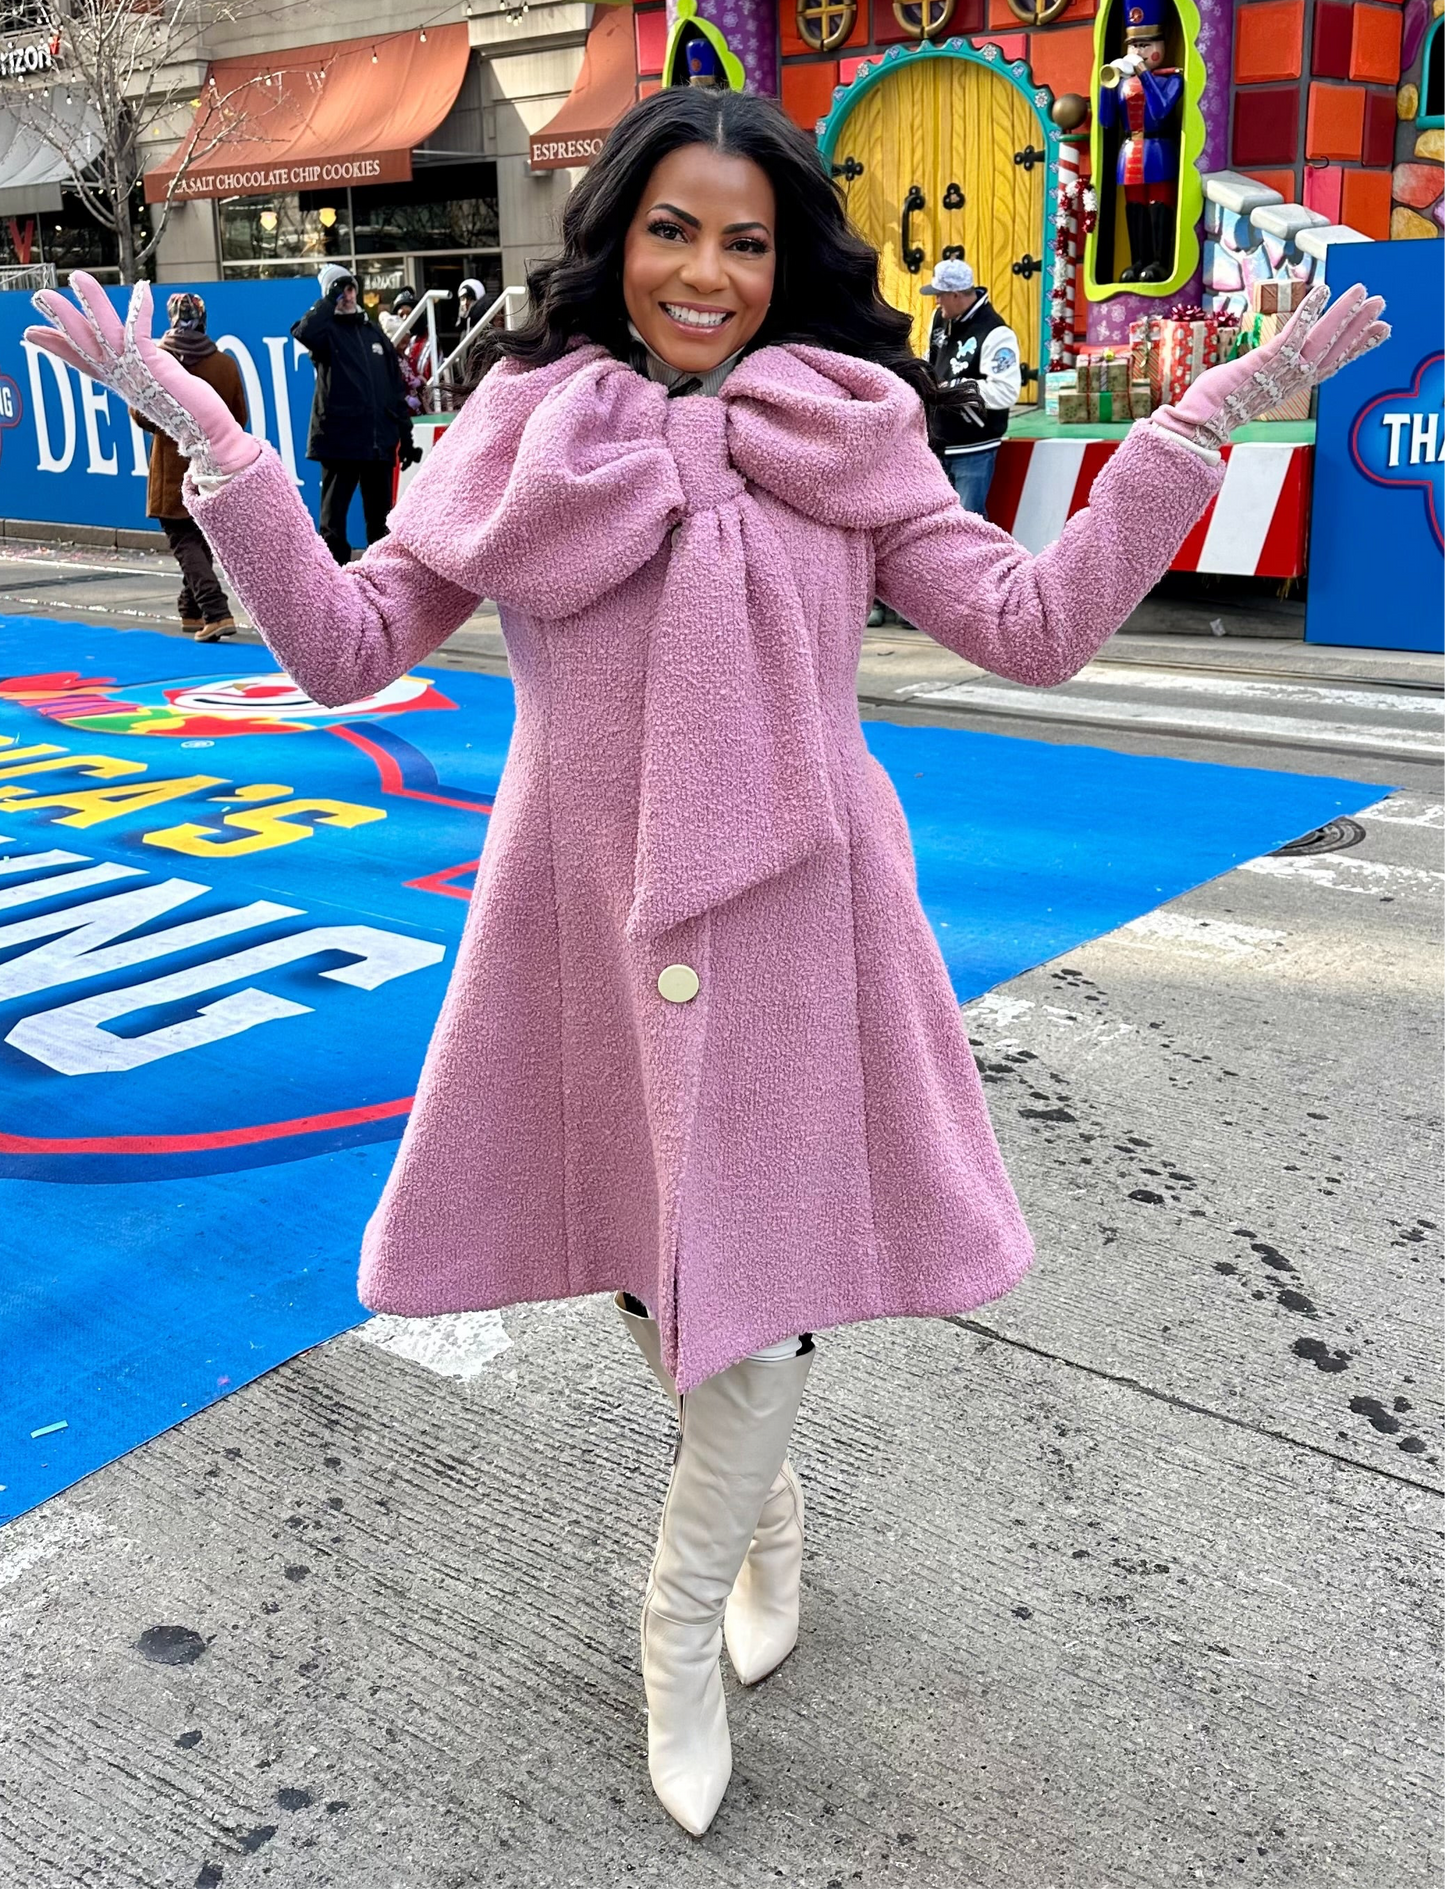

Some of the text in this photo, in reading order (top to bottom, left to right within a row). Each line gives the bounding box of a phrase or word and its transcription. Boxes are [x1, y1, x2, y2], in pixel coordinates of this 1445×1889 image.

[532, 138, 603, 161] ESPRESSO
[189, 176, 215, 191] SALT
[216, 168, 289, 189] CHOCOLATE
[290, 166, 321, 183] CHIP
[322, 160, 380, 180] COOKIES
[1382, 413, 1445, 467] TH
